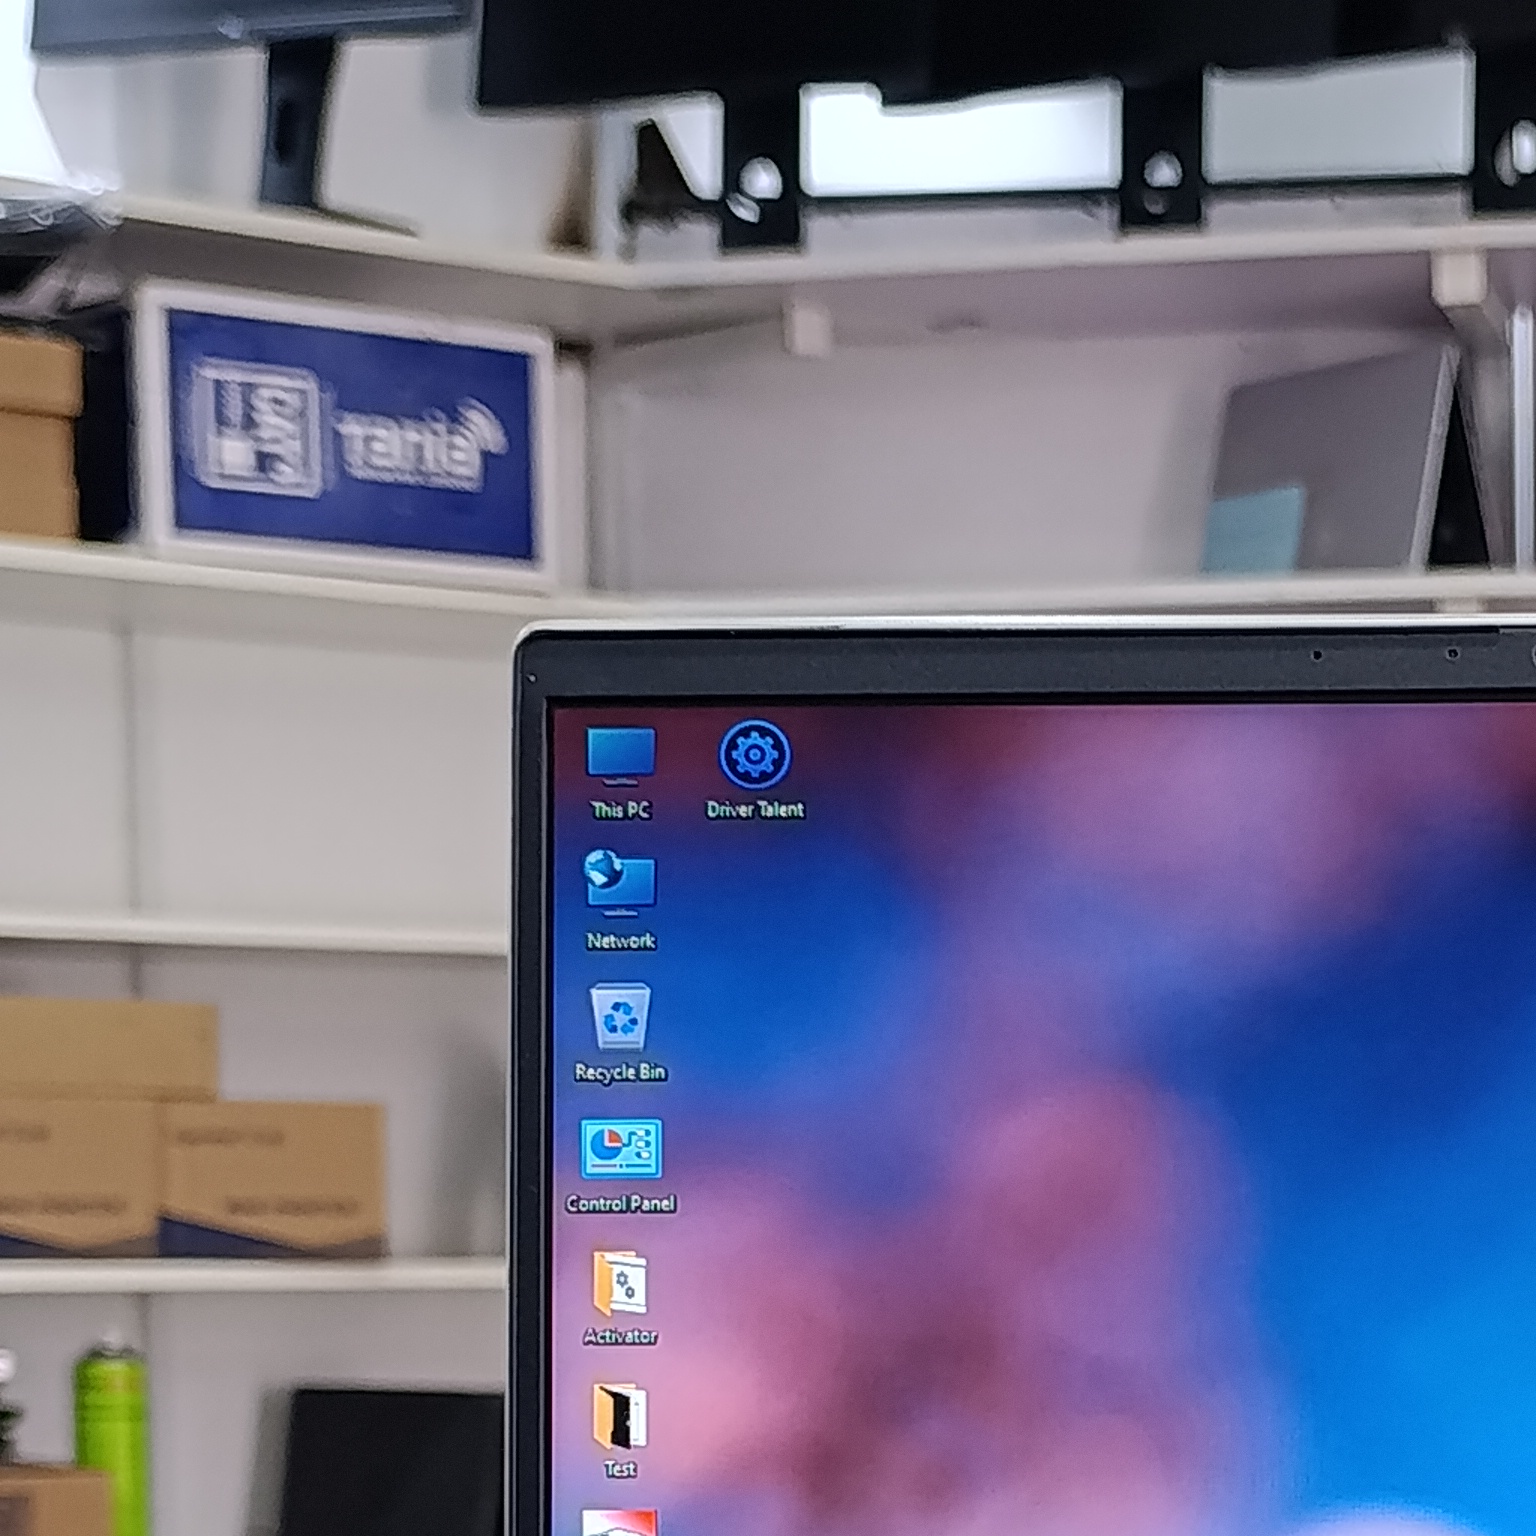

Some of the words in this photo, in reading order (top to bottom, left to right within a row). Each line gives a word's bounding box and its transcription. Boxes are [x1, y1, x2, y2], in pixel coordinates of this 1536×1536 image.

[590, 800, 624, 819] This
[627, 802, 651, 819] PC
[706, 800, 755, 819] Driver
[759, 800, 805, 819] Talent
[586, 932, 657, 949] Network
[575, 1063, 637, 1084] Recycle
[639, 1063, 666, 1079] Bin
[566, 1195, 627, 1212] Control
[630, 1195, 676, 1212] Panel
[583, 1328, 658, 1344] Activator
[604, 1461, 637, 1477] Test
